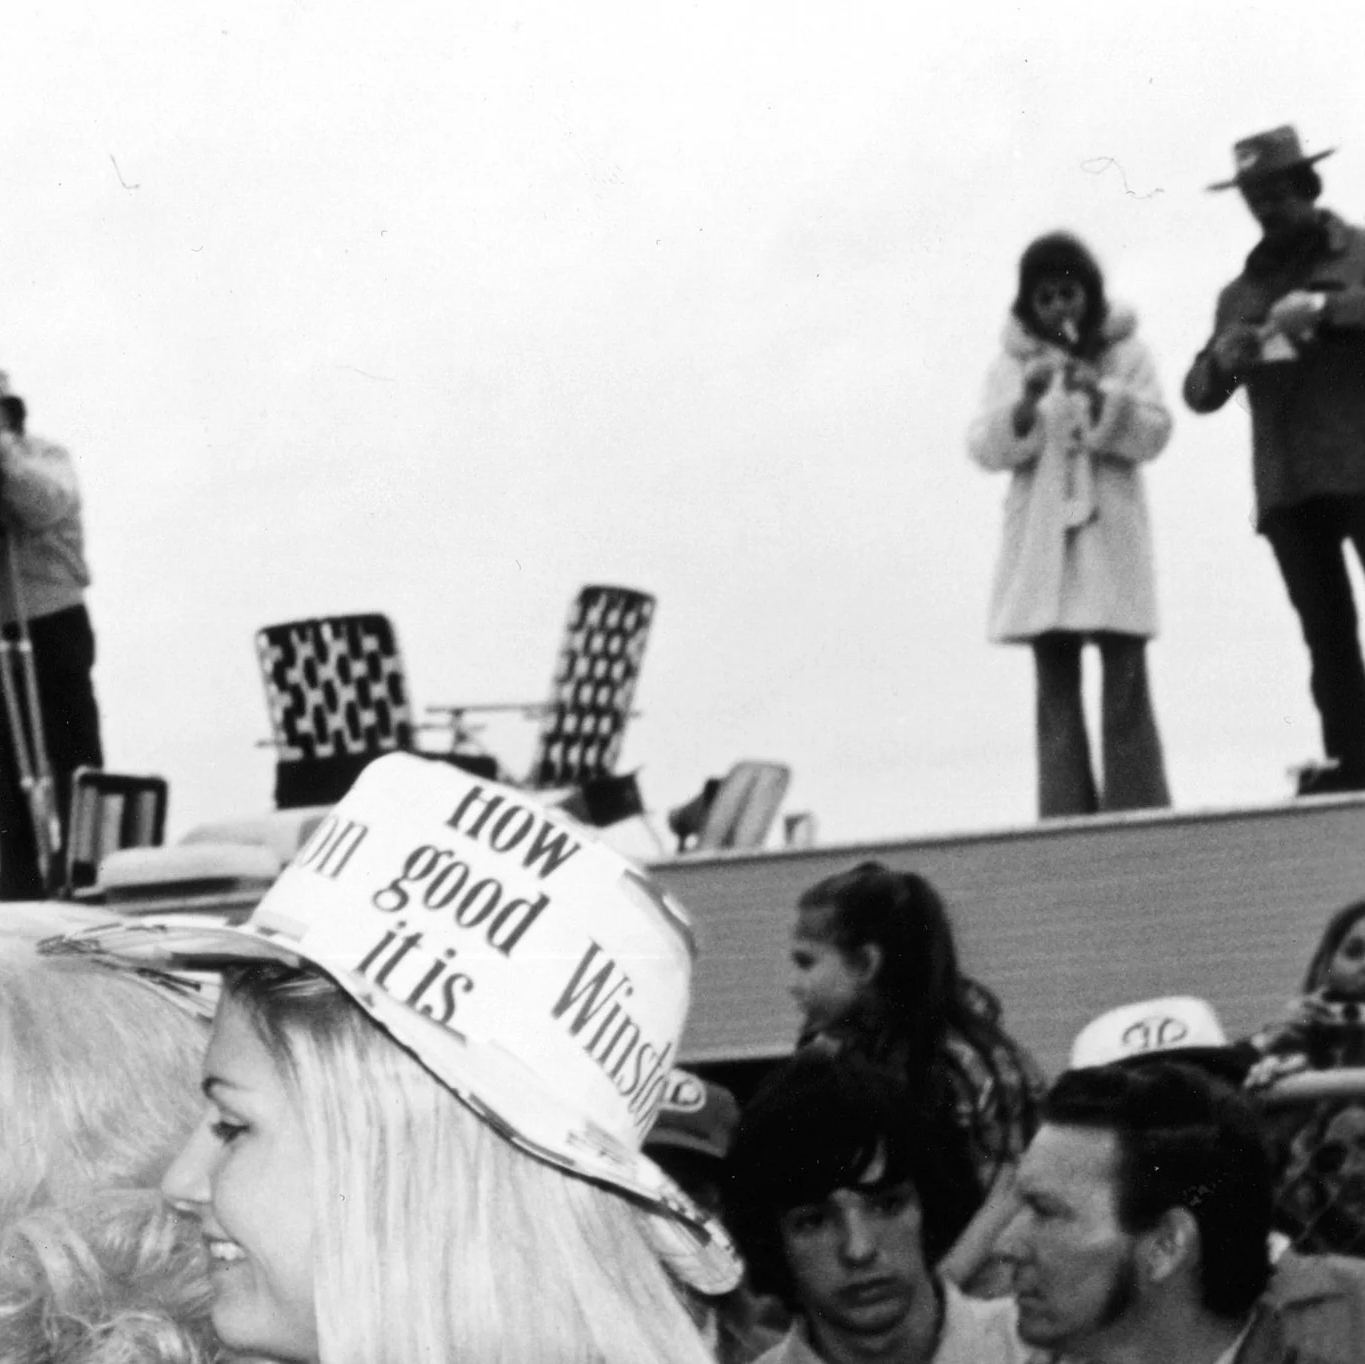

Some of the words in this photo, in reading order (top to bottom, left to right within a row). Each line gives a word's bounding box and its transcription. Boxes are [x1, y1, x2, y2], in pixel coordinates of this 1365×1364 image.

[444, 785, 582, 880] How
[372, 844, 551, 958] good
[354, 920, 424, 993] it
[405, 947, 474, 1025] is
